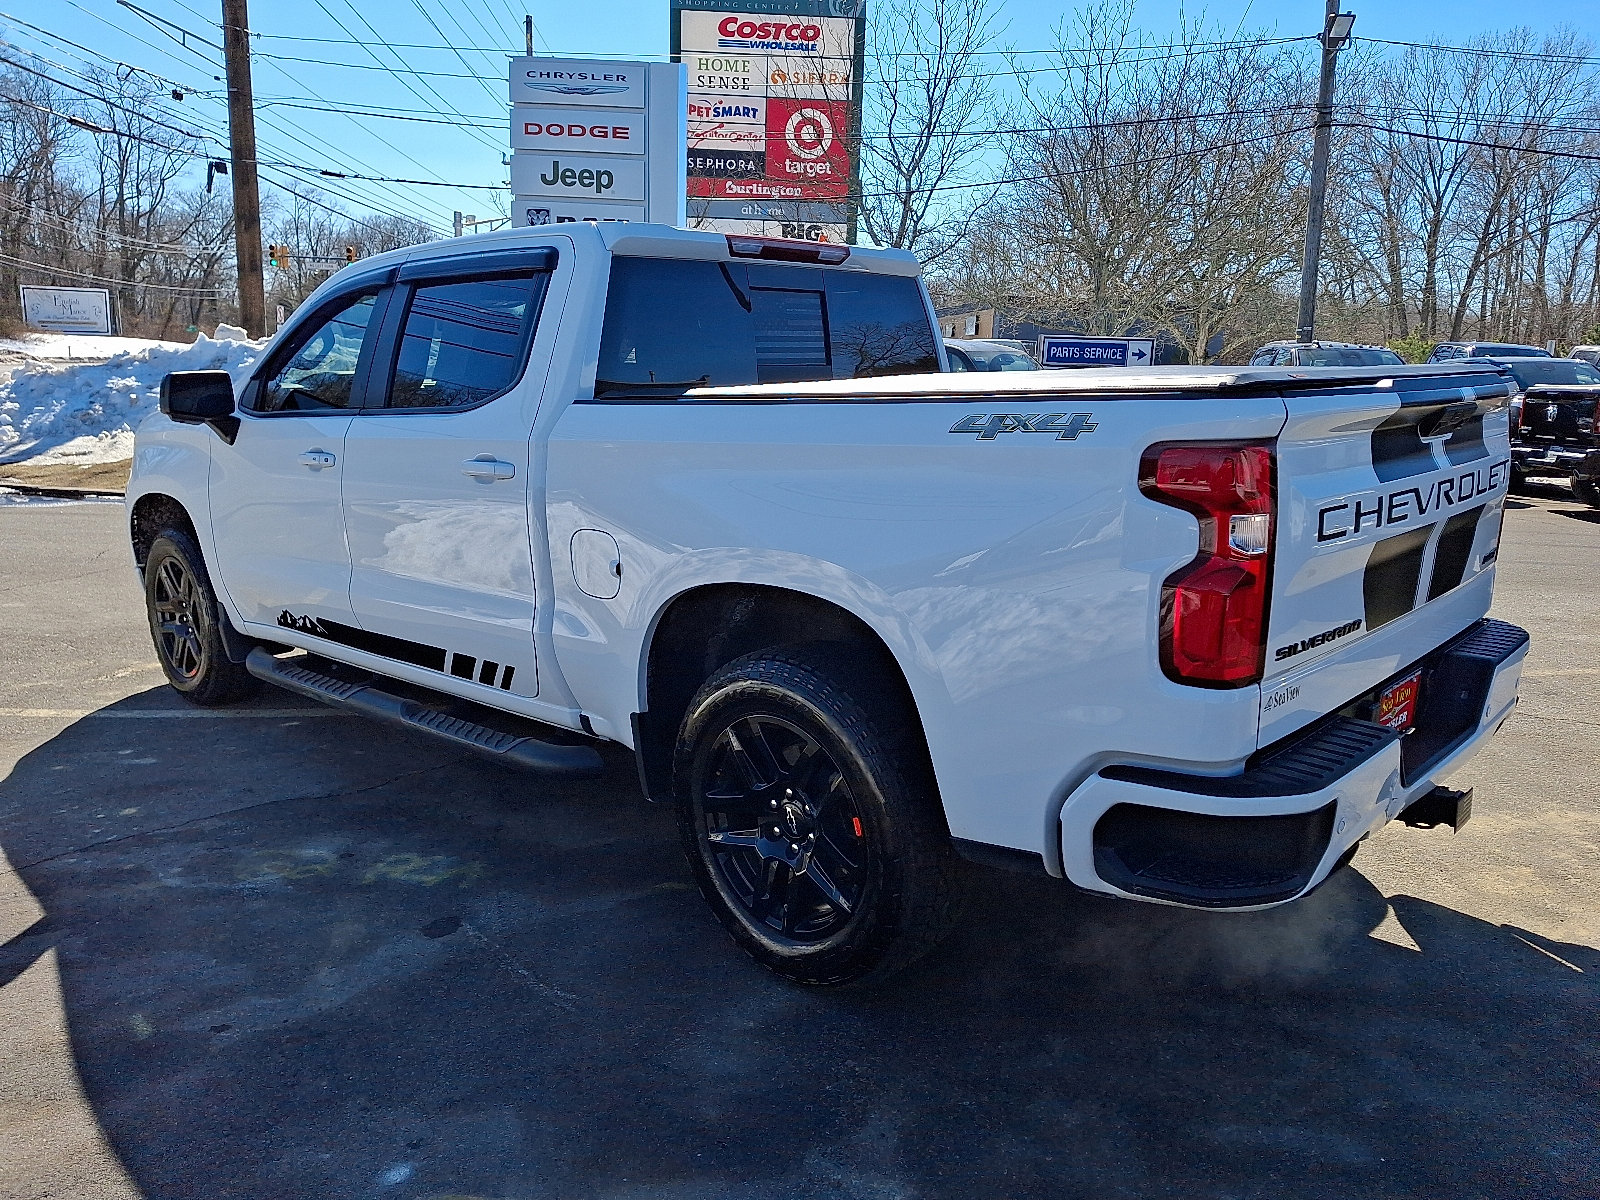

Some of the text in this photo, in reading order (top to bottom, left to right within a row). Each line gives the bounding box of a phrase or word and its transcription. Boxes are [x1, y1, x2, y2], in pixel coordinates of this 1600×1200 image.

[678, 0, 790, 10] SHOPPING CENTER
[718, 16, 820, 41] COSTCO
[750, 40, 818, 51] WHOLESALE
[697, 58, 750, 73] HOME
[526, 70, 628, 82] CHRYSLER
[697, 75, 750, 90] SENSE
[524, 123, 630, 140] DODGE
[688, 157, 756, 171] SEPHORA
[785, 158, 832, 176] target
[540, 160, 614, 194] Jeep
[725, 180, 803, 198] Burlington
[741, 203, 752, 215] at
[1050, 346, 1123, 360] PARTS-SERVICE
[1317, 458, 1510, 543] CHEVROLET
[1275, 618, 1363, 662] SILVERADO
